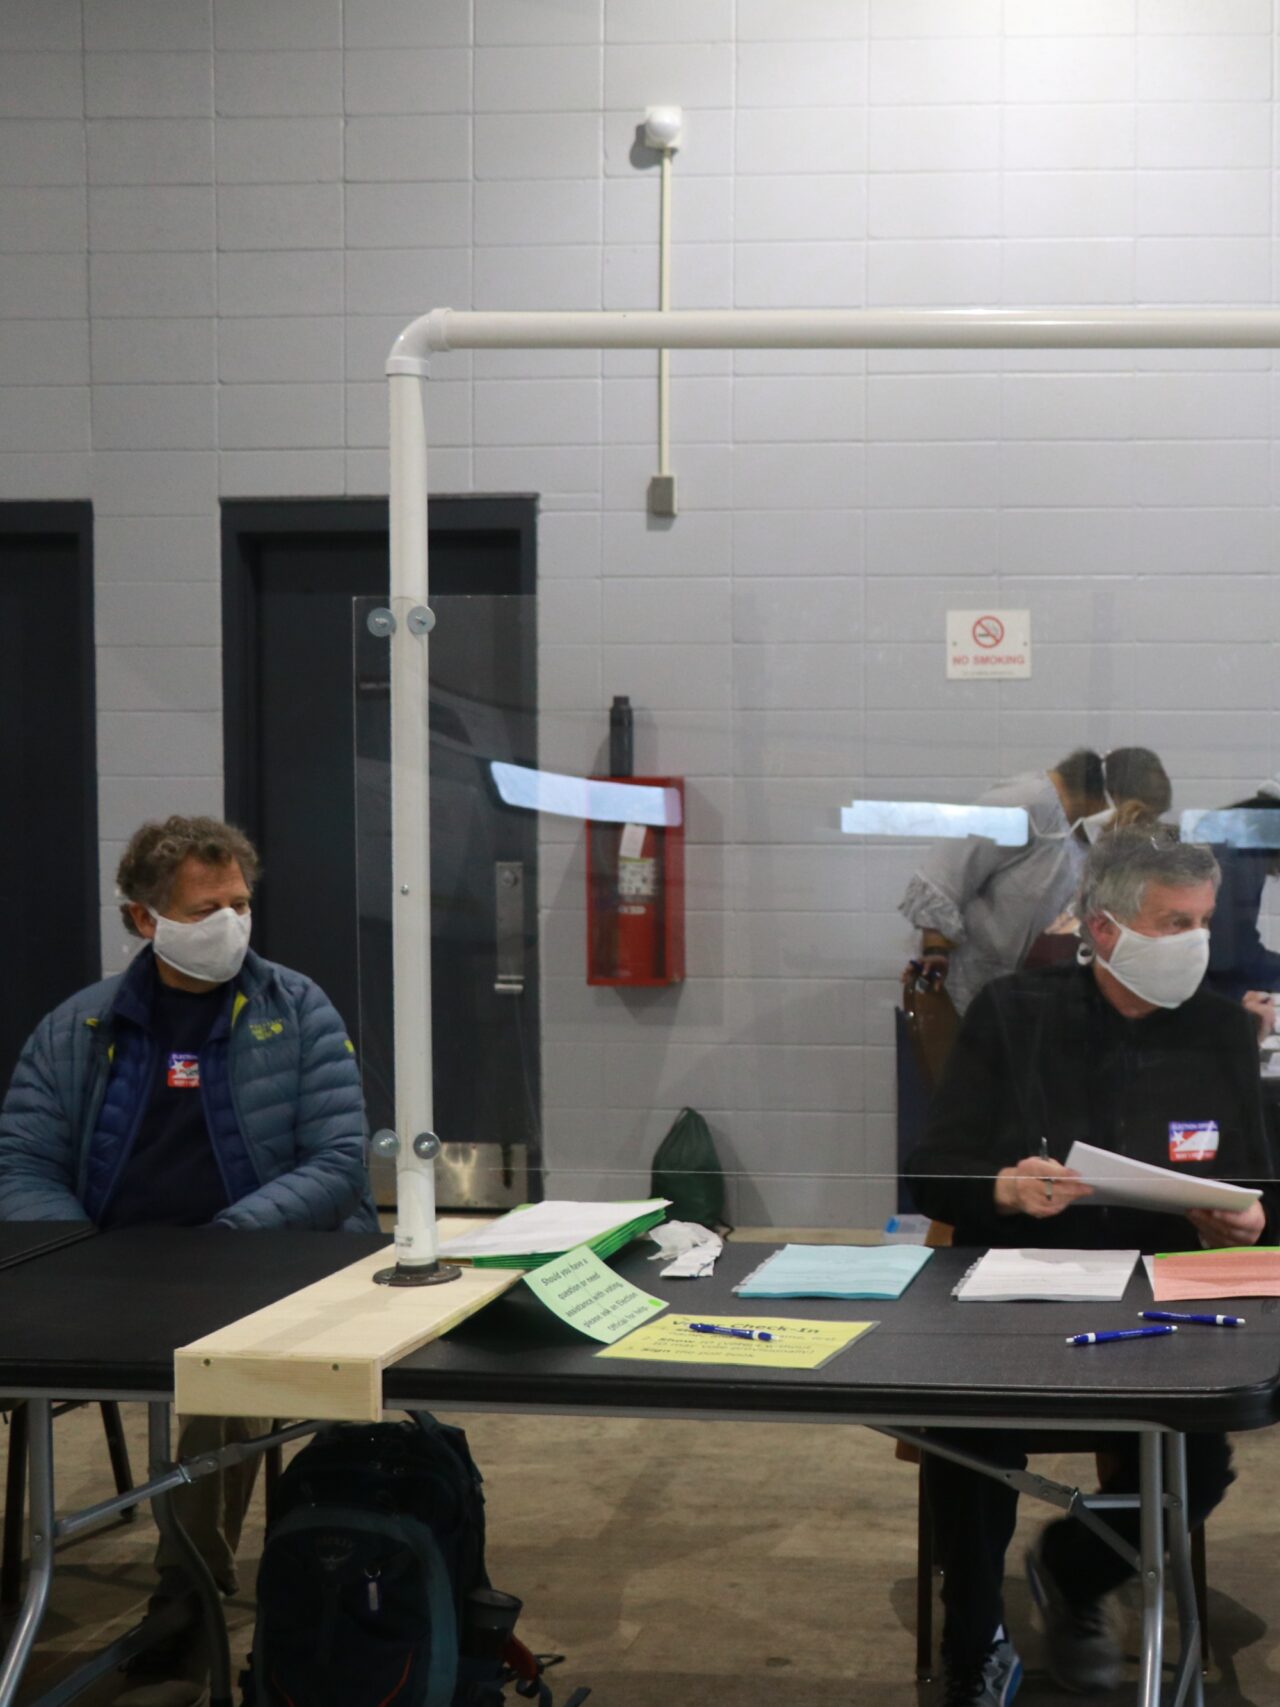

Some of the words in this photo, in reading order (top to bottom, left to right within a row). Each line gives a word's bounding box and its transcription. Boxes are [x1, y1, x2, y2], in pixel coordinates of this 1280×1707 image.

[952, 655, 970, 665] NO
[973, 655, 1025, 665] SMOKING
[541, 1271, 562, 1286] Should
[560, 1267, 571, 1278] you
[569, 1261, 584, 1271] have
[558, 1283, 581, 1300] question
[580, 1279, 588, 1287] or
[587, 1271, 601, 1283] need
[565, 1298, 593, 1317] assistance
[592, 1290, 606, 1301] with
[583, 1315, 603, 1328] please
[615, 1292, 639, 1307] Election
[731, 1323, 820, 1333] Check-In
